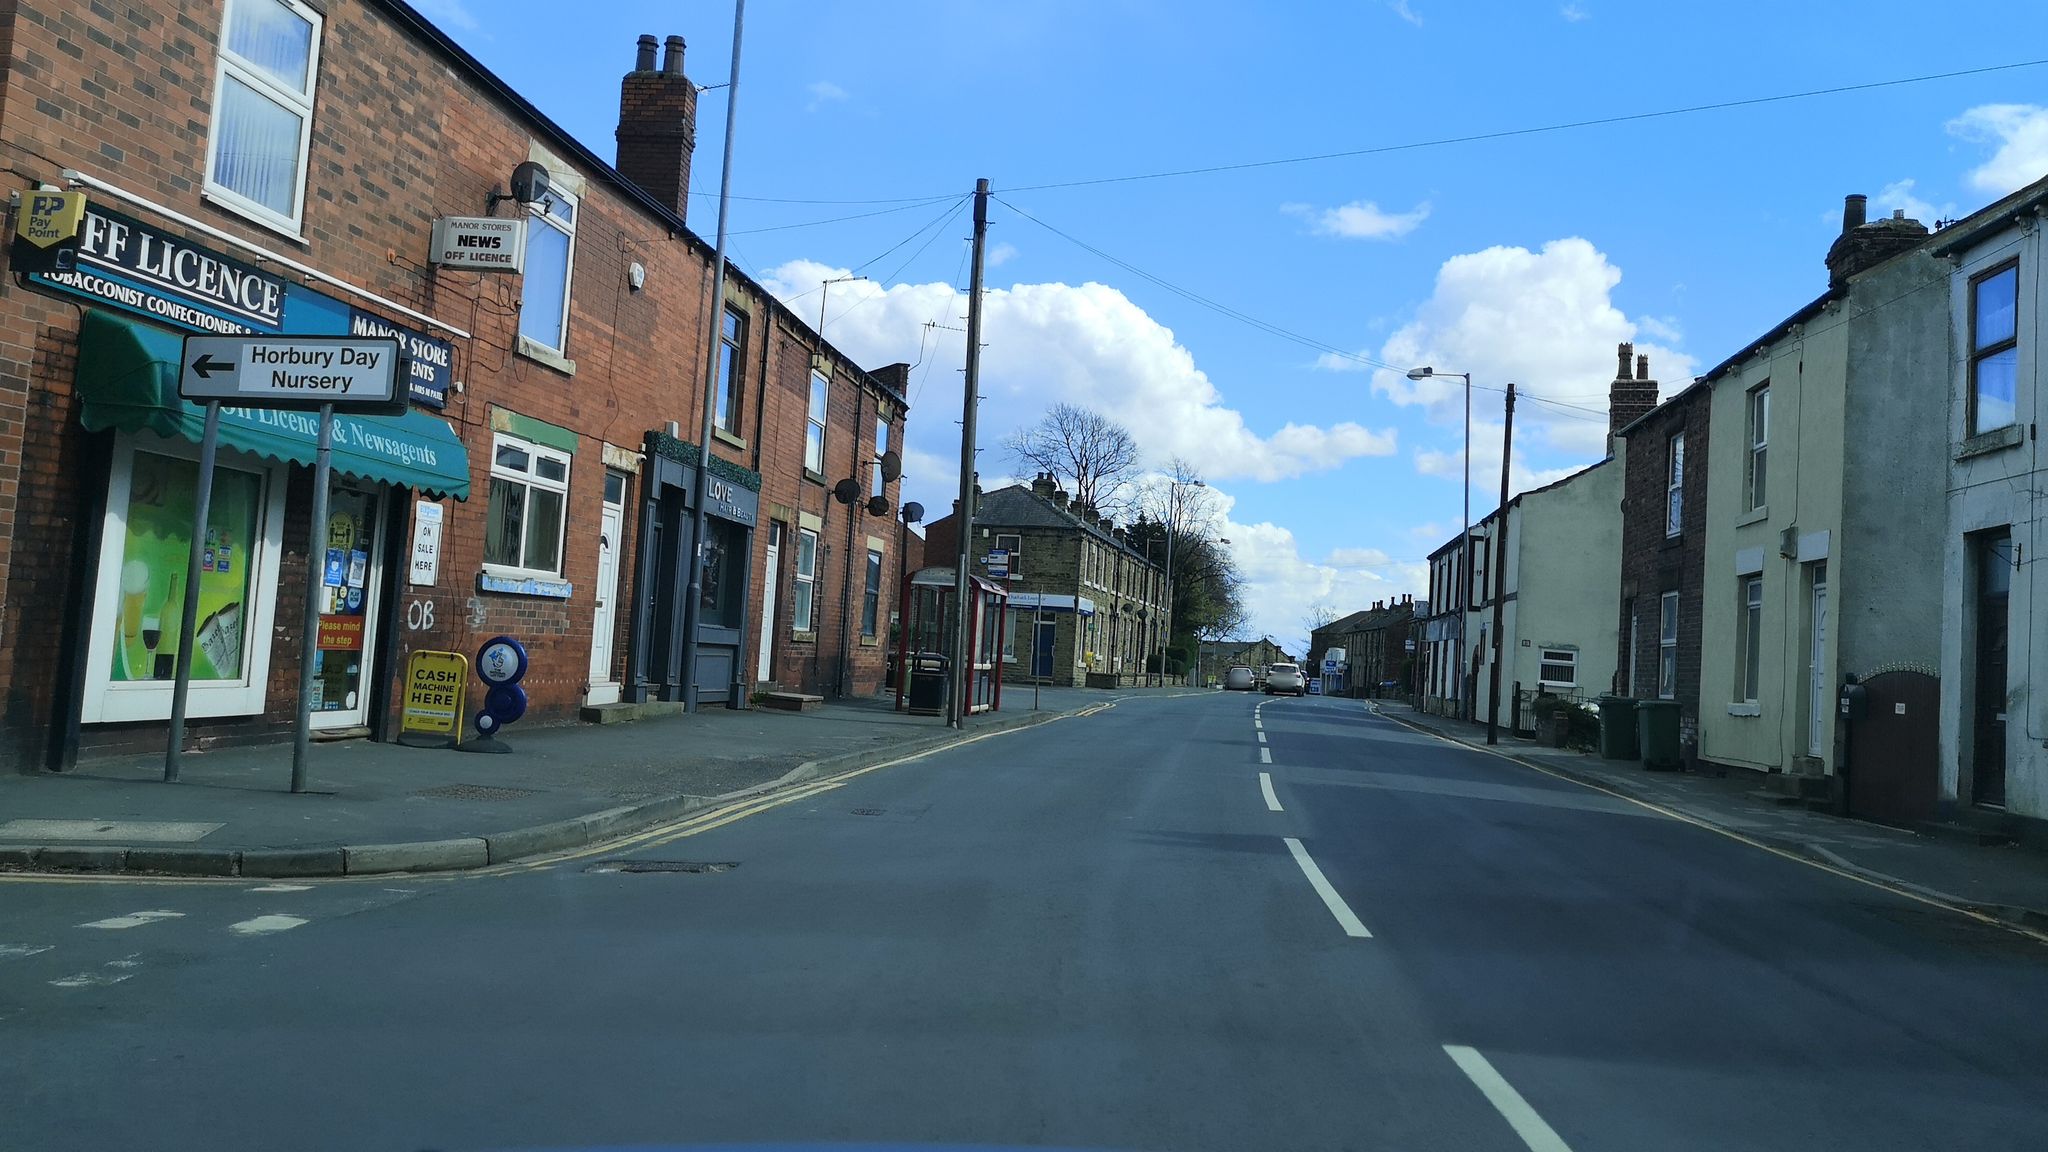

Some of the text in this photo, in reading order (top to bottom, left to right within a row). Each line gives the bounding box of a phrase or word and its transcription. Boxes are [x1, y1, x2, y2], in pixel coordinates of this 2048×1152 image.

[30, 216, 51, 230] Pay
[451, 222, 512, 232] MANOR STORES
[28, 227, 60, 239] Point
[457, 234, 502, 249] NEWS
[445, 250, 512, 263] OFF LICENCE
[80, 211, 280, 318] FF LICENCE
[146, 295, 242, 334] CONFECTIONERS
[251, 346, 380, 370] Horbury Day
[410, 337, 448, 367] STORE
[411, 360, 435, 382] ENTS
[271, 370, 353, 394] Nursery
[259, 408, 320, 437] Licenc
[332, 417, 348, 445] &
[349, 422, 438, 467] Newsagents
[708, 477, 733, 504] LOVE
[422, 526, 432, 537] ON
[417, 543, 433, 554] SALE
[414, 560, 433, 571] HERE
[319, 620, 361, 632] Please mind
[323, 634, 353, 646] the step
[415, 669, 457, 683] CASH
[413, 682, 455, 693] MACHINE
[411, 692, 453, 706] HERE
